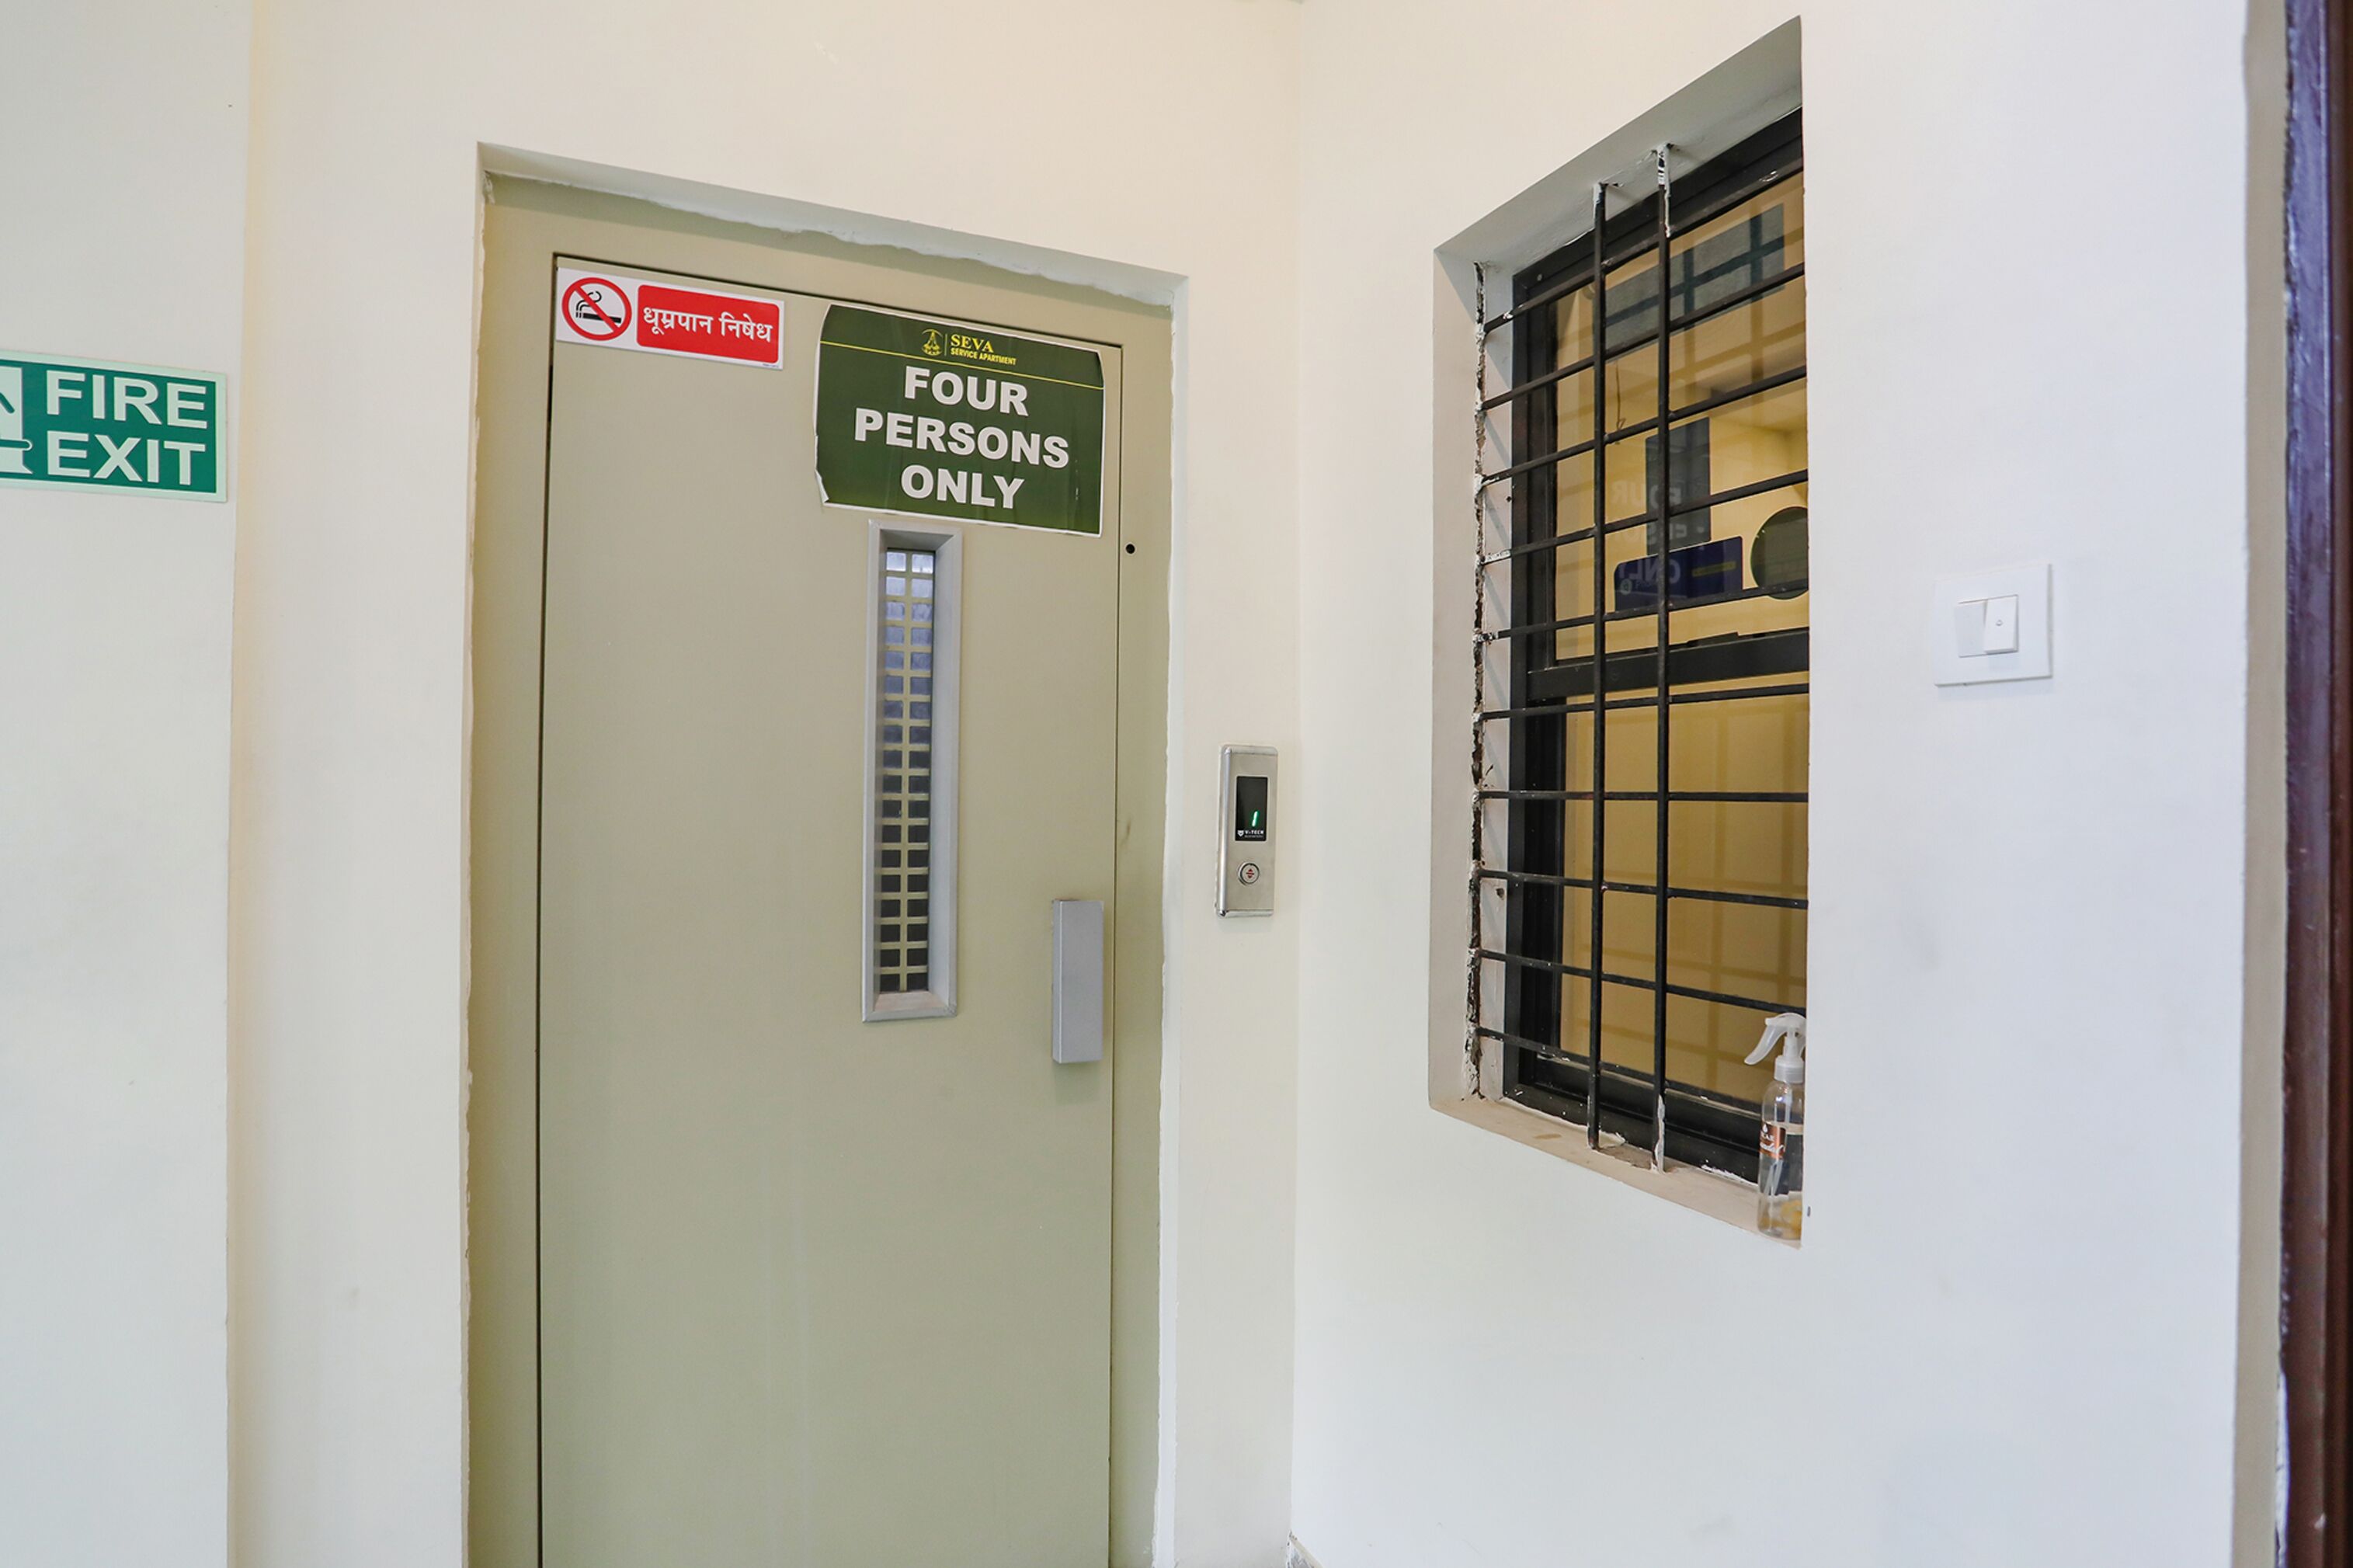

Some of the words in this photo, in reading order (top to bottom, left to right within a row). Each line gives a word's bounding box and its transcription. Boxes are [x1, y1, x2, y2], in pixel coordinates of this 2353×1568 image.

[643, 306, 714, 336] धूम्रपान
[719, 311, 773, 342] निषेध
[950, 333, 994, 353] SEVA
[950, 347, 978, 359] SERVICE
[979, 353, 1017, 366] APARTMENT
[47, 369, 207, 429] FIRE
[904, 365, 1029, 416] FOUR
[47, 430, 207, 485] EXIT
[854, 407, 1069, 468] PERSONS
[901, 464, 1024, 509] ONLY
